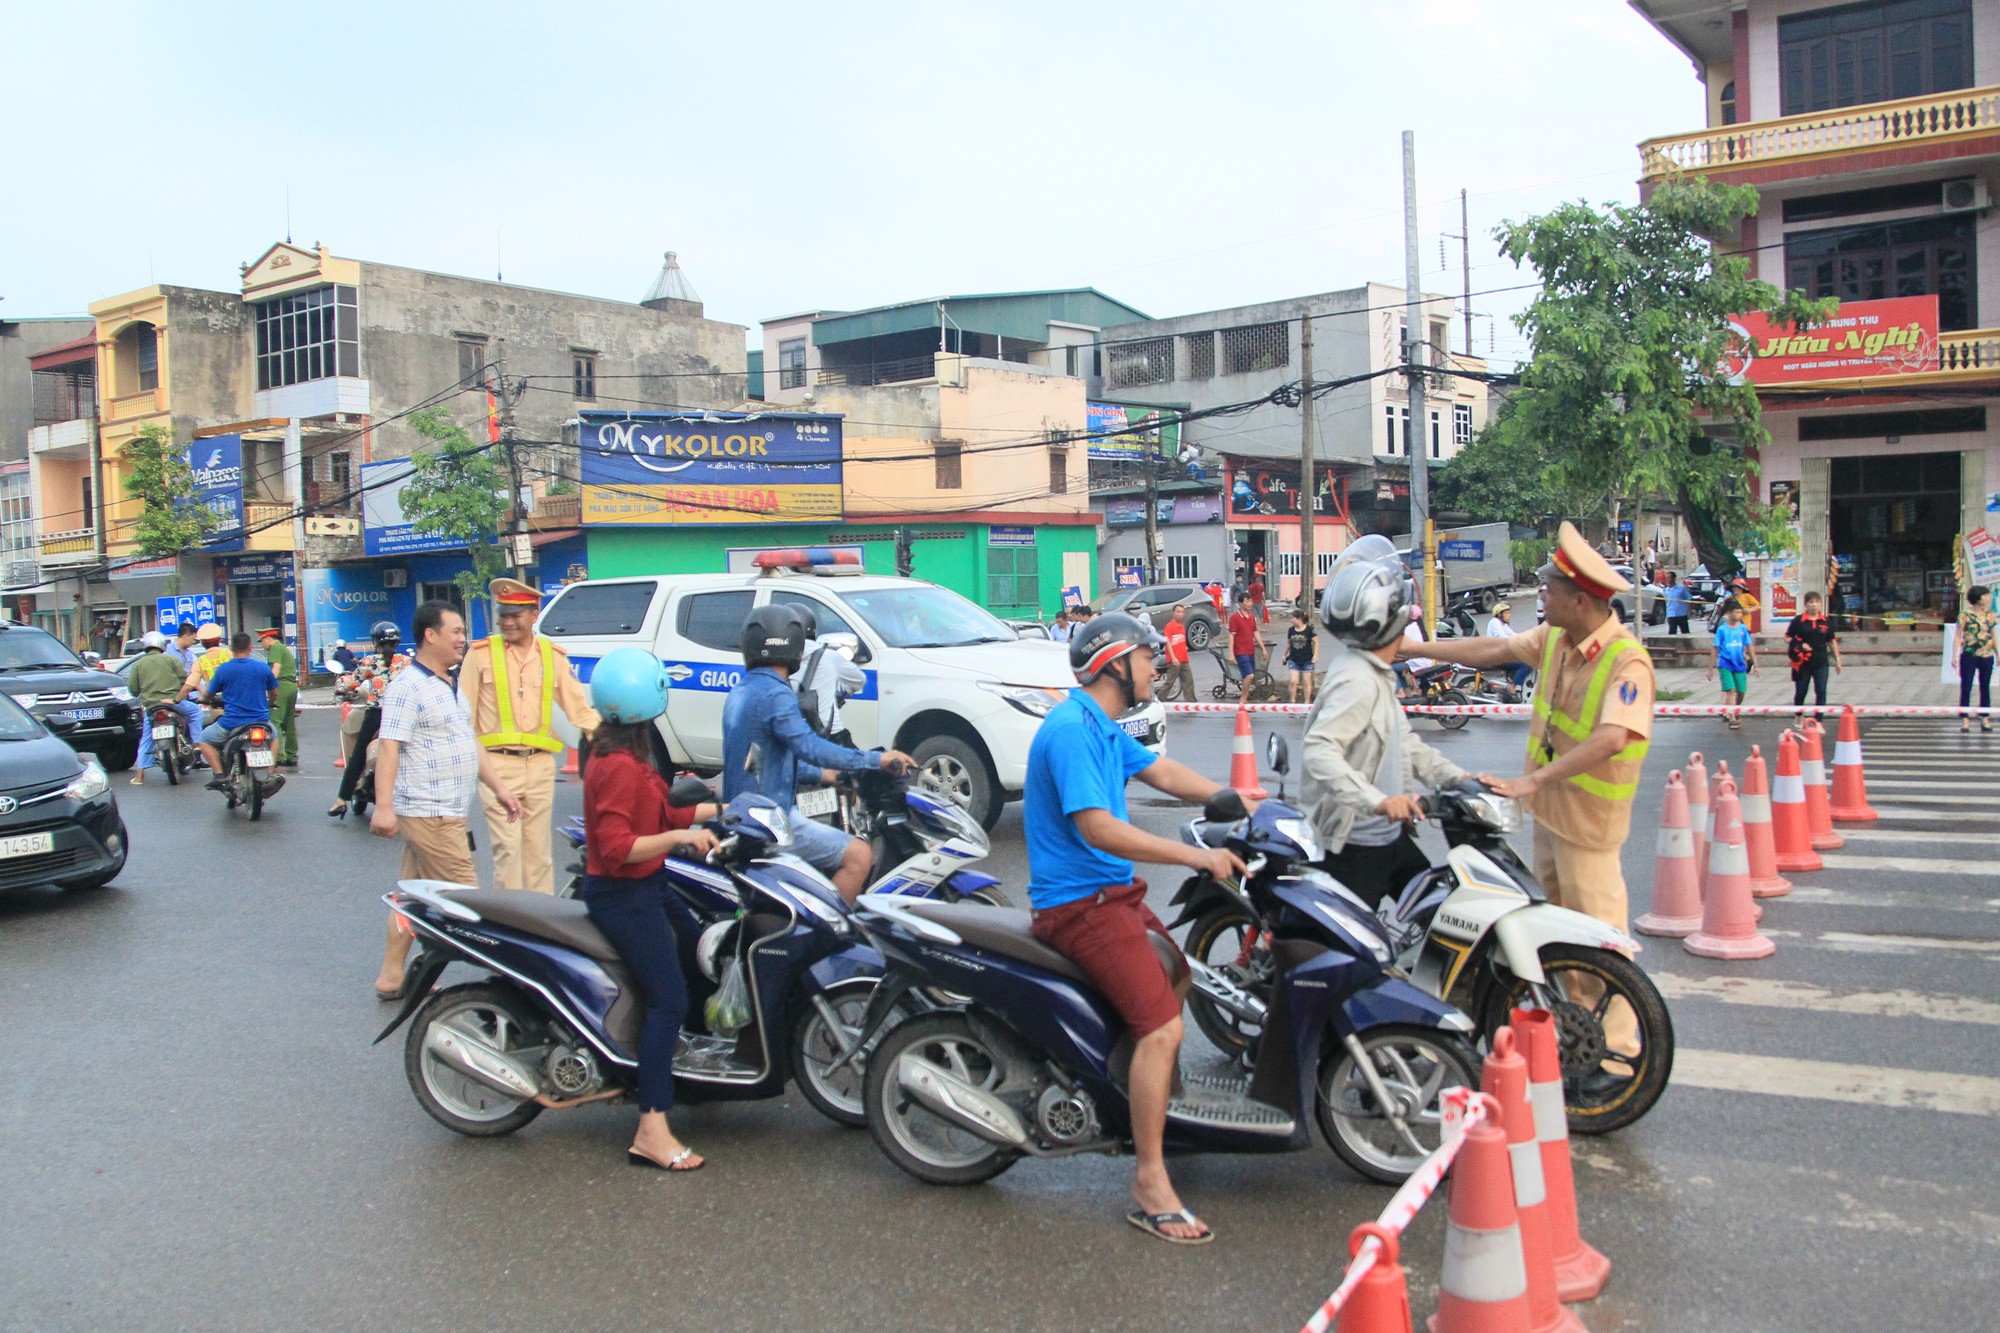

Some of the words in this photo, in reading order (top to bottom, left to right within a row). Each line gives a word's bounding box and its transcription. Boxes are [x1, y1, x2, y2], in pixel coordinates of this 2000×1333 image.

[1860, 315, 1878, 325] THU
[1758, 335, 1830, 357] Hữu
[1834, 321, 1921, 356] Nghị
[700, 670, 740, 688] GIAO
[1440, 912, 1479, 932] YAMAHA
